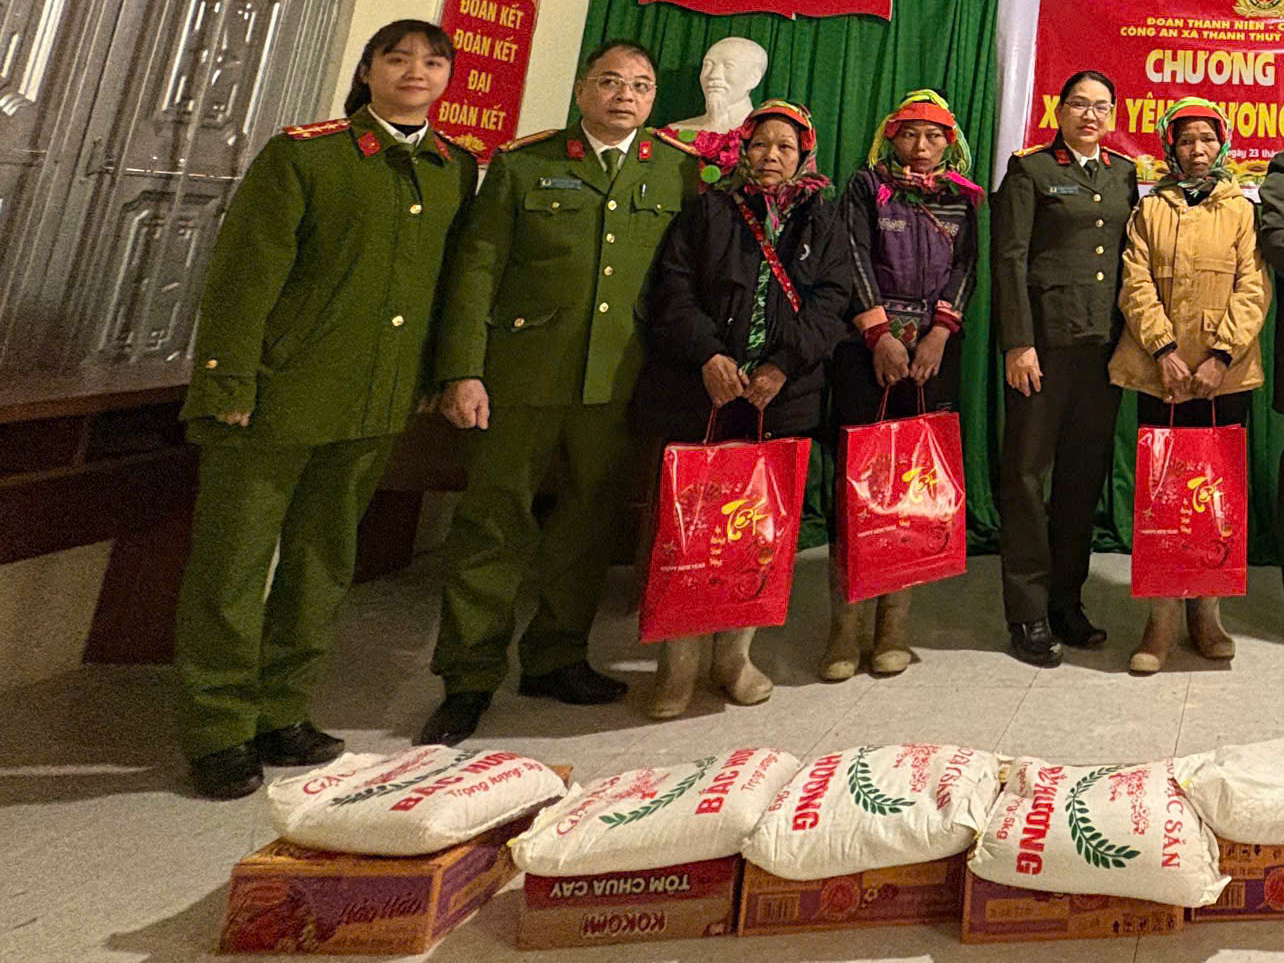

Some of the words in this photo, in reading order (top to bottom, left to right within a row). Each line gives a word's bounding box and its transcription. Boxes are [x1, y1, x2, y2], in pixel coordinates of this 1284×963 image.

[500, 2, 525, 30] KẾT
[1187, 18, 1231, 30] THANH
[454, 28, 490, 59] ĐOÀN
[493, 36, 518, 63] KẾT
[1160, 27, 1179, 38] AN
[1202, 29, 1246, 41] THANH
[1145, 48, 1276, 87] CHƯƠNG
[467, 69, 492, 97] ĐẠI
[438, 101, 479, 128] ĐOÀN
[480, 103, 507, 132] KẾT
[549, 882, 589, 898] CAY
[593, 876, 646, 896] CHUA
